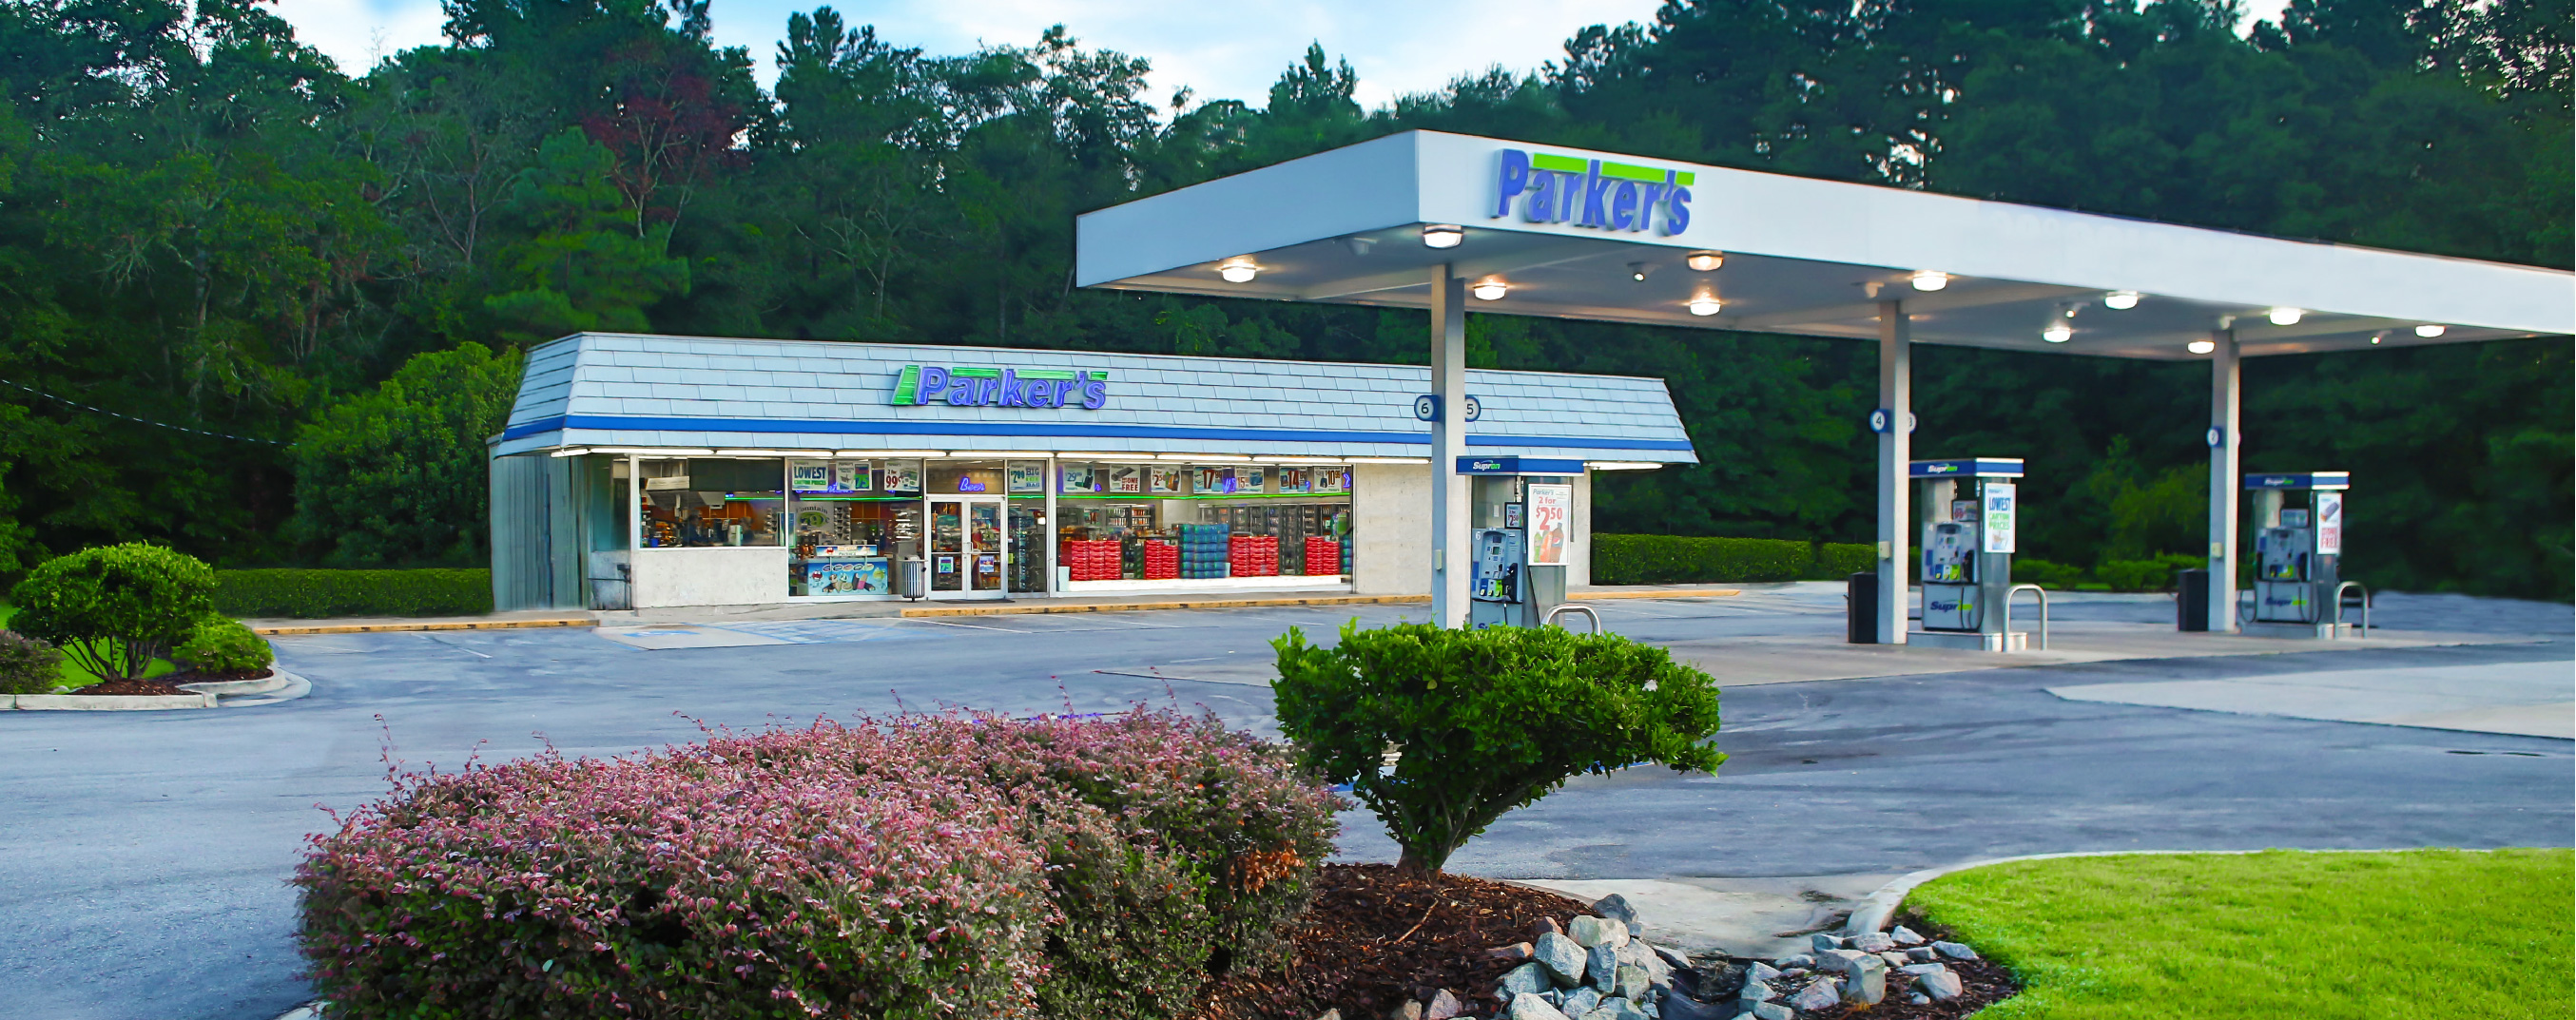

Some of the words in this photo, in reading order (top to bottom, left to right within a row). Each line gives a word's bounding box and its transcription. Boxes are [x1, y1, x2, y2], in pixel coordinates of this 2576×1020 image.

[1490, 148, 1693, 237] Parker's
[916, 366, 1107, 410] Parker's
[1421, 402, 1429, 414] 6
[1466, 403, 1474, 415] 5
[1875, 415, 1883, 426] 4
[793, 466, 827, 479] LOWEST
[1538, 496, 1543, 505] 2
[1545, 496, 1557, 505] for
[1475, 530, 1482, 541] 6
